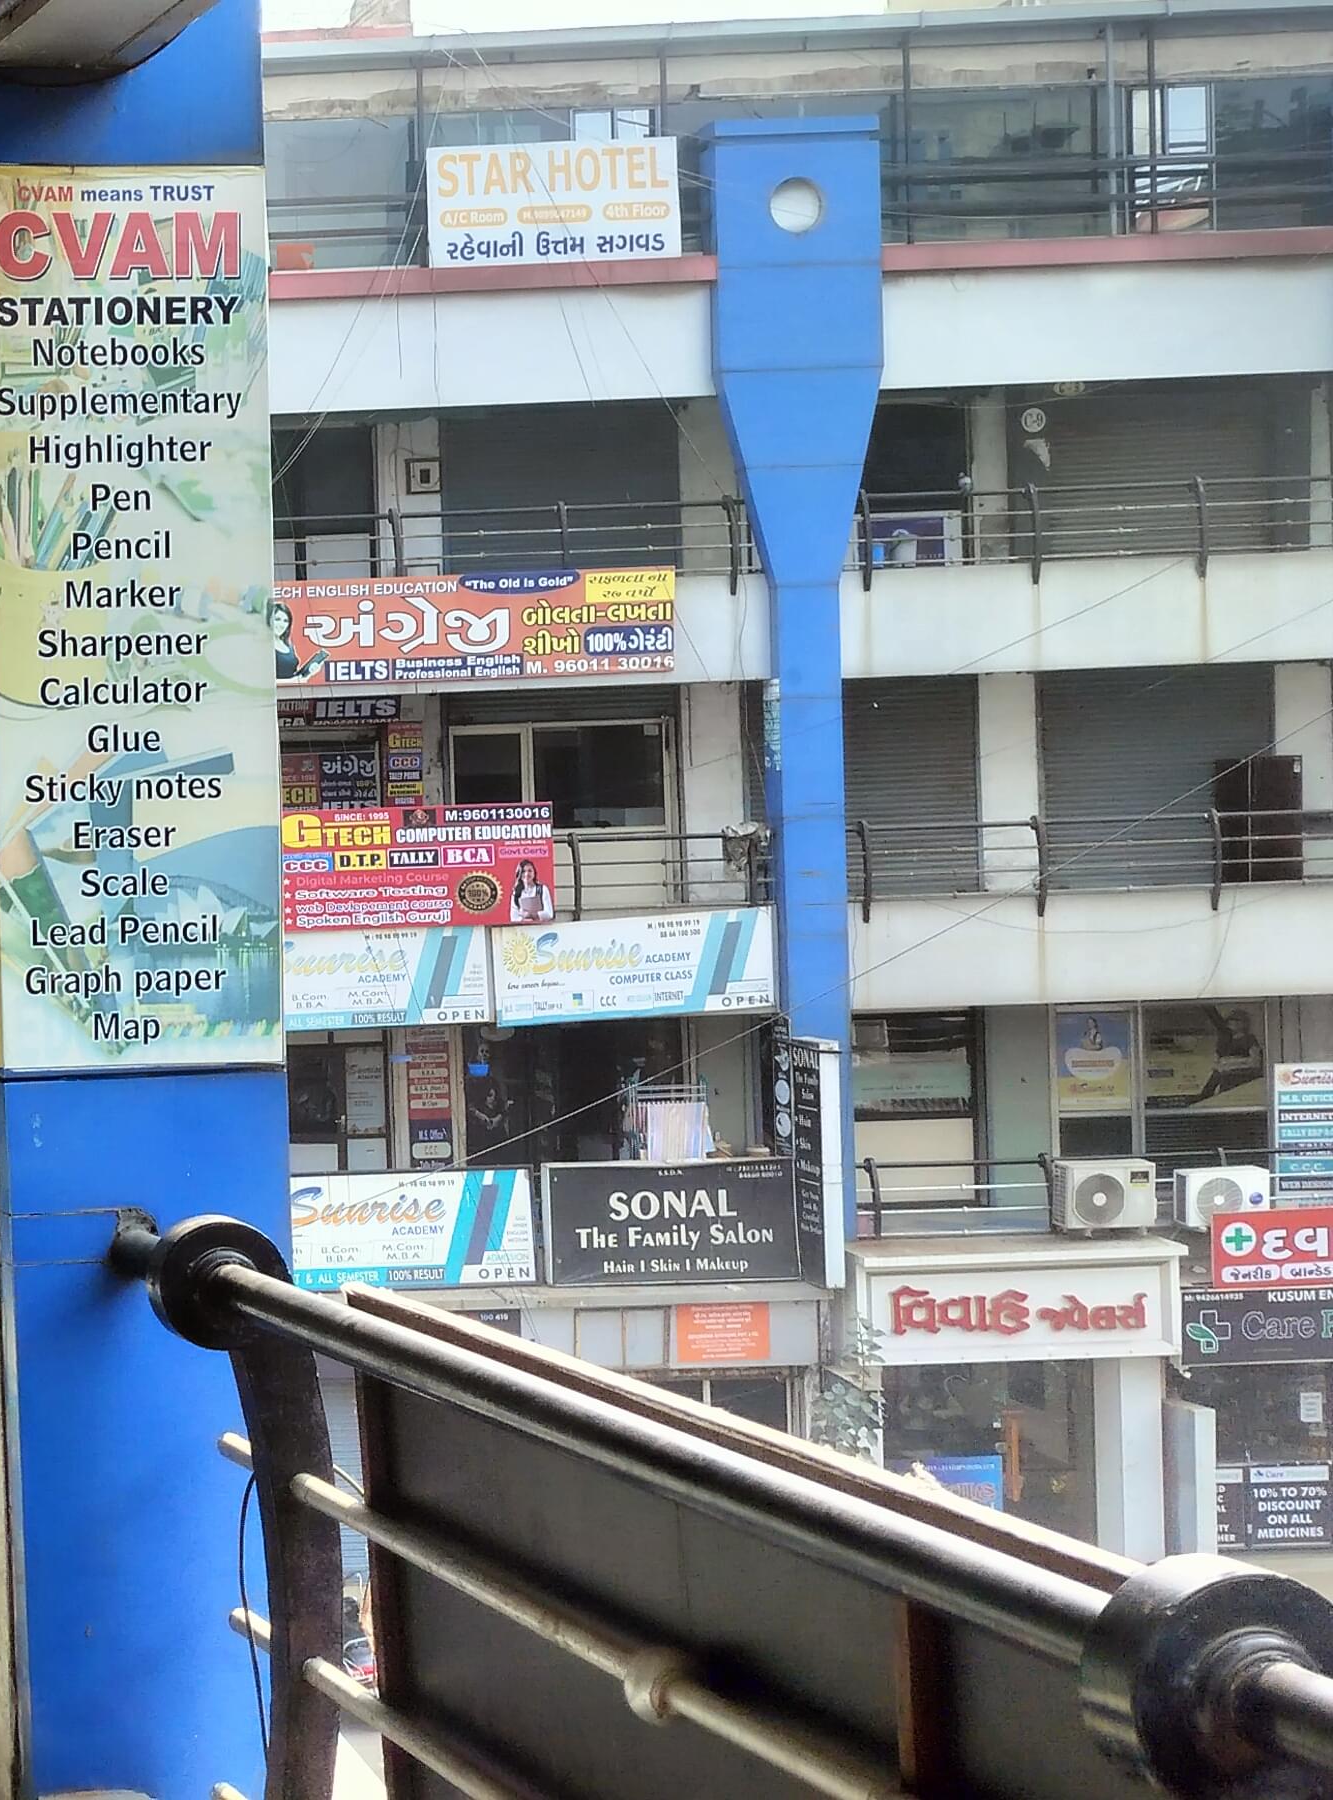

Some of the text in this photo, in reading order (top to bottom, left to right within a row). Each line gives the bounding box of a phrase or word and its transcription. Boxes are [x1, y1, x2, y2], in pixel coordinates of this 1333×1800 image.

[438, 146, 669, 197] STAR HOTEL
[18, 185, 214, 201] CVAM means TRUST
[444, 211, 504, 224] A/C Room
[606, 205, 666, 217] 4th Floor
[447, 231, 665, 260] રહેવાની ઉત્તમ સગવડ
[32, 338, 205, 366] Notebooks
[30, 434, 211, 468] Highlighter
[91, 484, 151, 510] Pen
[72, 531, 171, 559] Pencil
[307, 581, 457, 597] ENGLISH EDUCATION
[499, 577, 519, 588] Old
[65, 581, 180, 608] Marker
[303, 597, 510, 655] અંગ્રેજી
[38, 629, 207, 661] Sharpener
[523, 627, 581, 655] શીખો
[587, 632, 626, 651] 100%
[396, 655, 520, 669] Business English
[527, 655, 674, 674] M. 96011 30016
[329, 662, 387, 681] IELTS
[395, 666, 520, 679] Professional English
[40, 677, 207, 706] Calculator
[316, 699, 396, 718] IELTS
[88, 725, 161, 752] Glue
[322, 755, 376, 777] અંગ્રેજી
[390, 757, 420, 767] CCC
[25, 774, 222, 806] Sticky notes
[335, 812, 389, 822] SINCE: 1995
[445, 807, 549, 821] M:9601130016
[74, 822, 175, 849] Eraser
[396, 824, 551, 843] COMPUTER EDUCATION
[391, 852, 435, 864] TALLY
[447, 848, 490, 863] BCA
[500, 847, 520, 855] Govt
[284, 861, 329, 872] CCC
[339, 854, 383, 868] D.T.P.
[81, 868, 168, 896] Scale
[297, 873, 449, 888] Digital Marketing Course
[296, 885, 448, 900] Software Testing
[296, 903, 324, 914] web
[412, 901, 452, 909] course
[297, 910, 451, 928] Spoken English Guruji
[32, 915, 218, 946] Lead Pencil
[533, 932, 643, 974] Sunrise
[645, 952, 691, 963] ACADEMY
[25, 967, 226, 998] Graph paper
[358, 974, 406, 983] ACADEMY
[609, 970, 692, 985] COMPUTER CLASS
[600, 996, 616, 1007] CCC
[654, 990, 683, 1001] INTERNET
[722, 994, 769, 1007] OPEN
[354, 1013, 405, 1023] 100% RESULT
[437, 1009, 484, 1021] OPEN
[93, 1013, 160, 1042] Map
[793, 1047, 819, 1070] SONAL
[291, 1186, 446, 1230] Sunrise
[609, 1189, 737, 1221] SONAL
[392, 1225, 445, 1236] ACADEMY
[575, 1222, 774, 1250] The Family Salon
[1261, 1228, 1329, 1260] દવ
[479, 1267, 530, 1279] OPEN
[603, 1257, 749, 1274] Hair Skin Makeup
[306, 1268, 444, 1284] & ALL SEMESTER 100% RESULT
[1268, 1291, 1316, 1303] KUSUM
[889, 1286, 1030, 1335] વિવાહ
[1242, 1310, 1316, 1340] Care
[1253, 1487, 1327, 1498] 10% TO 70%
[1258, 1500, 1322, 1512] DISCOUNT
[1267, 1514, 1312, 1525] ON ALL
[1257, 1527, 1324, 1539] MEDICINES
